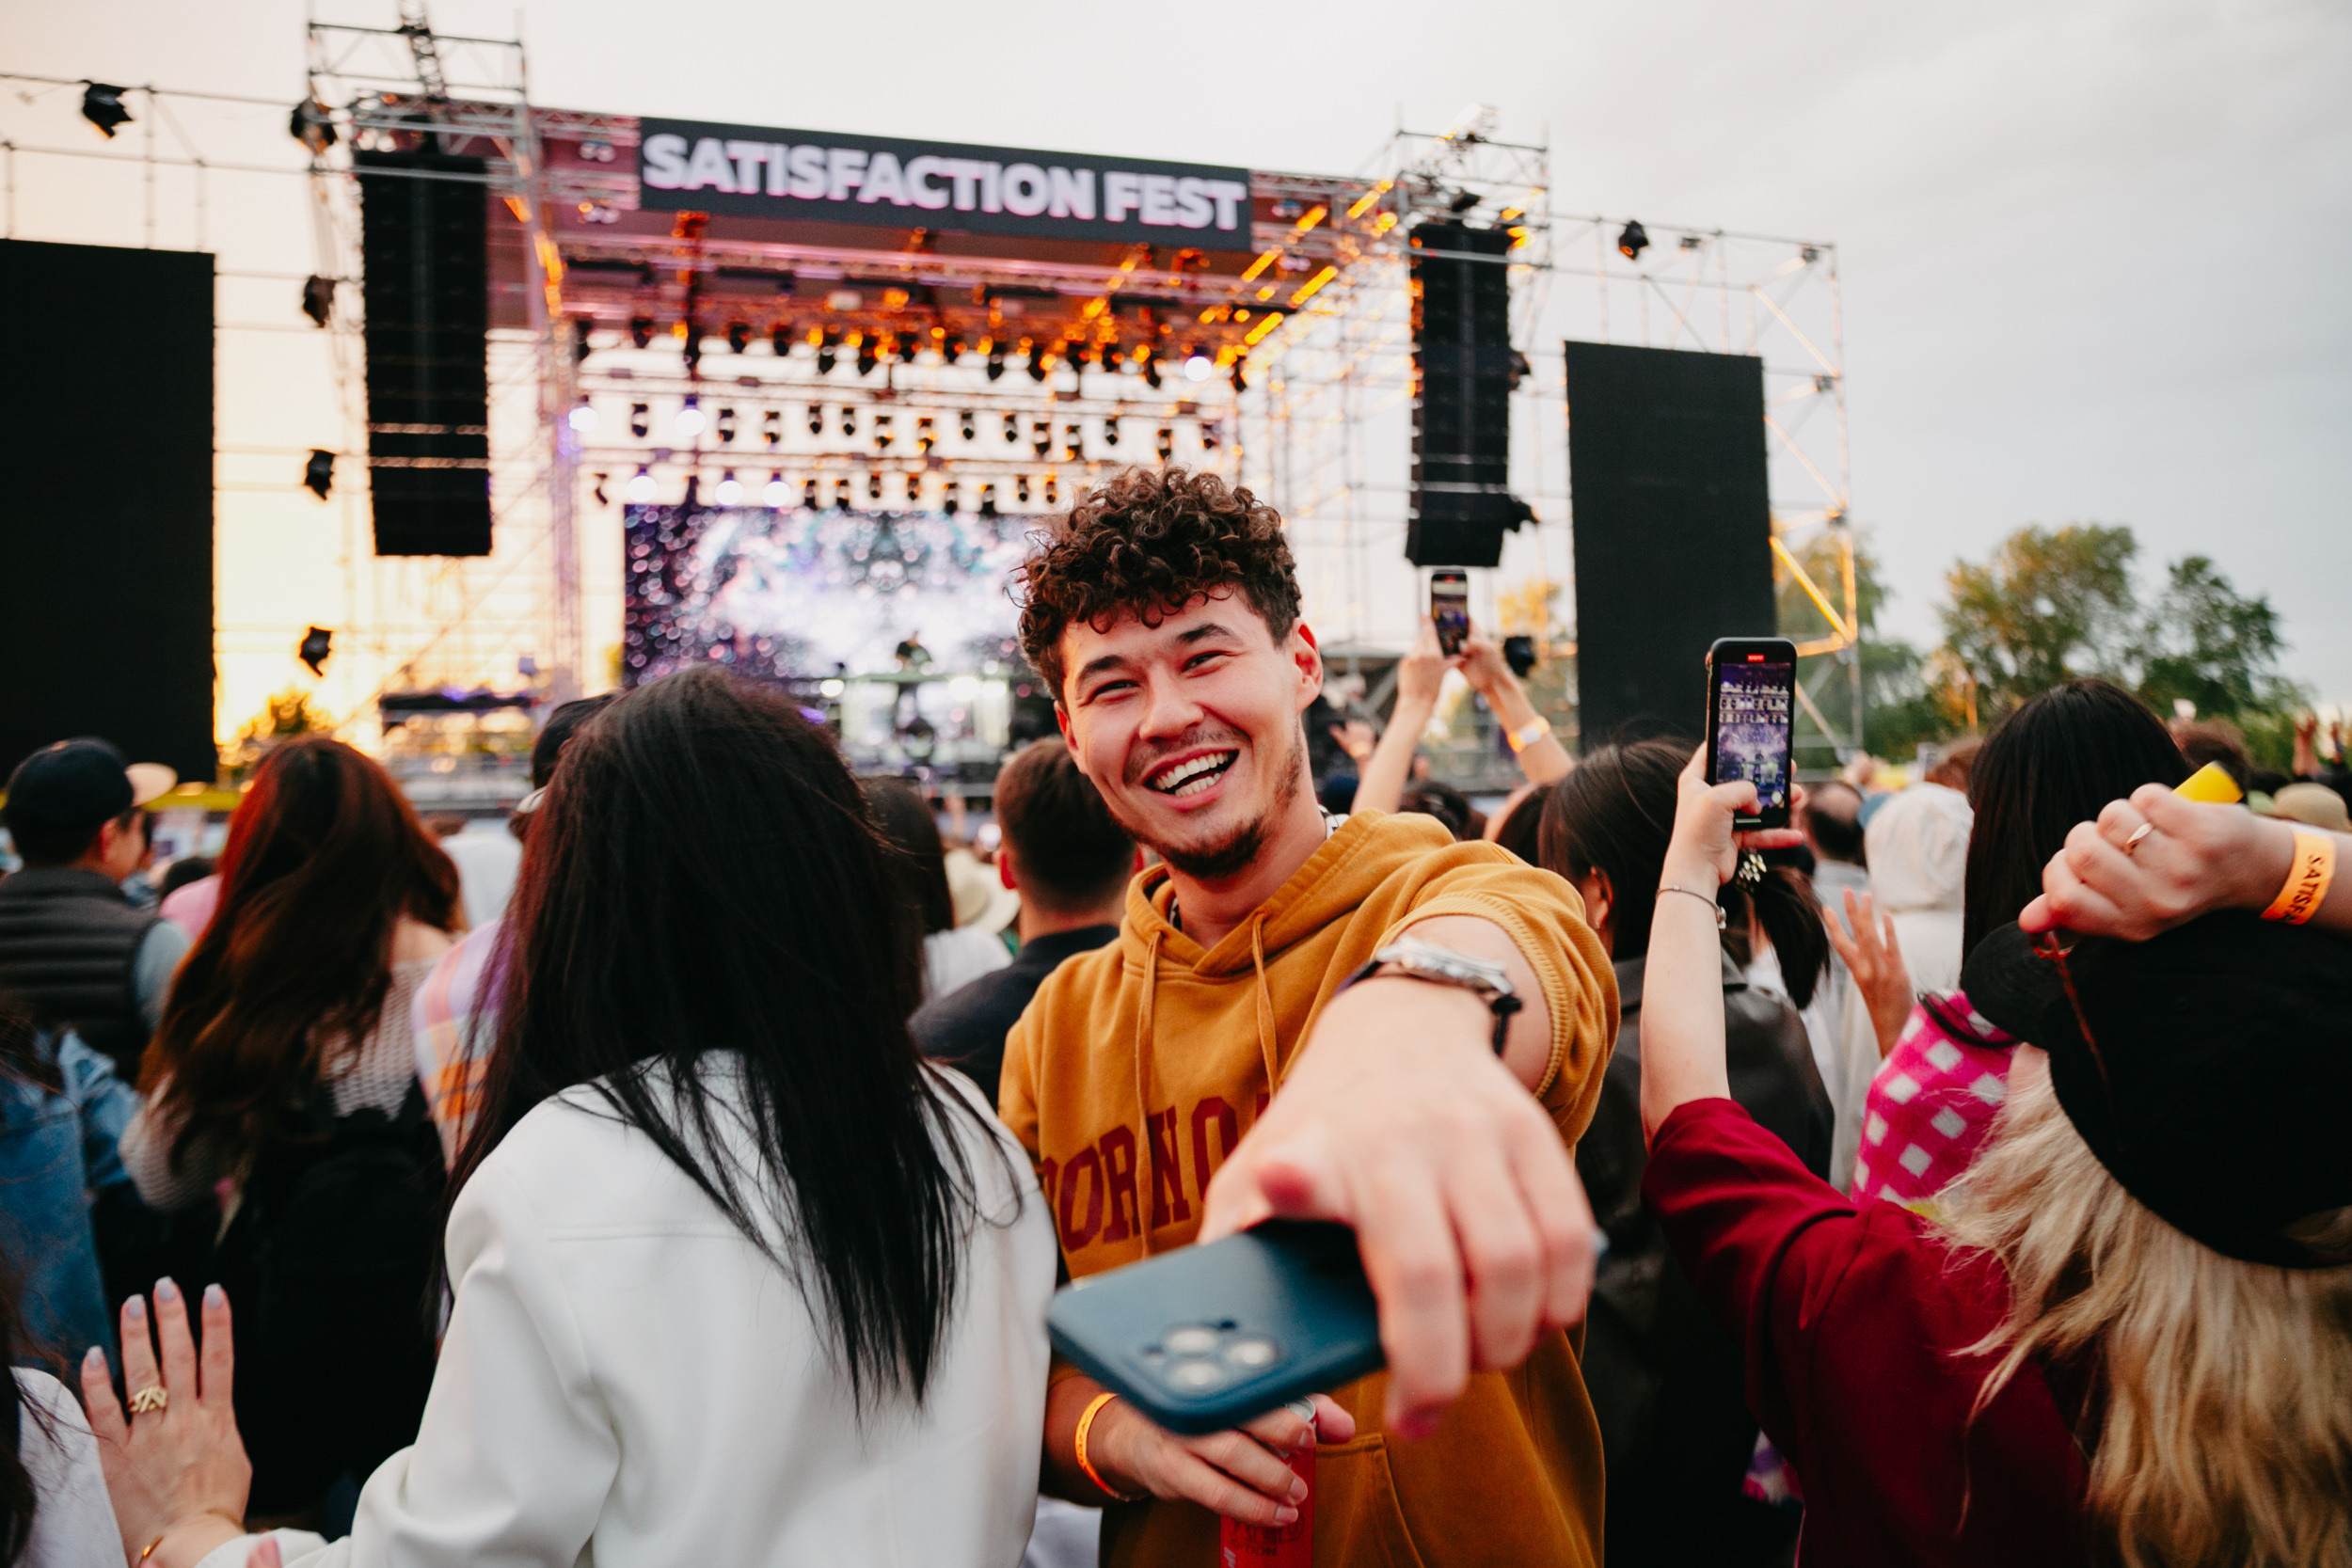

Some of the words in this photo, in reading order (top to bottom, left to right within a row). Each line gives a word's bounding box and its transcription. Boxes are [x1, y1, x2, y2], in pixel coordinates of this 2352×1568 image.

[643, 134, 1096, 221] SATISFACTION
[1103, 170, 1248, 230] FEST
[1041, 1092, 1271, 1253] ORNO
